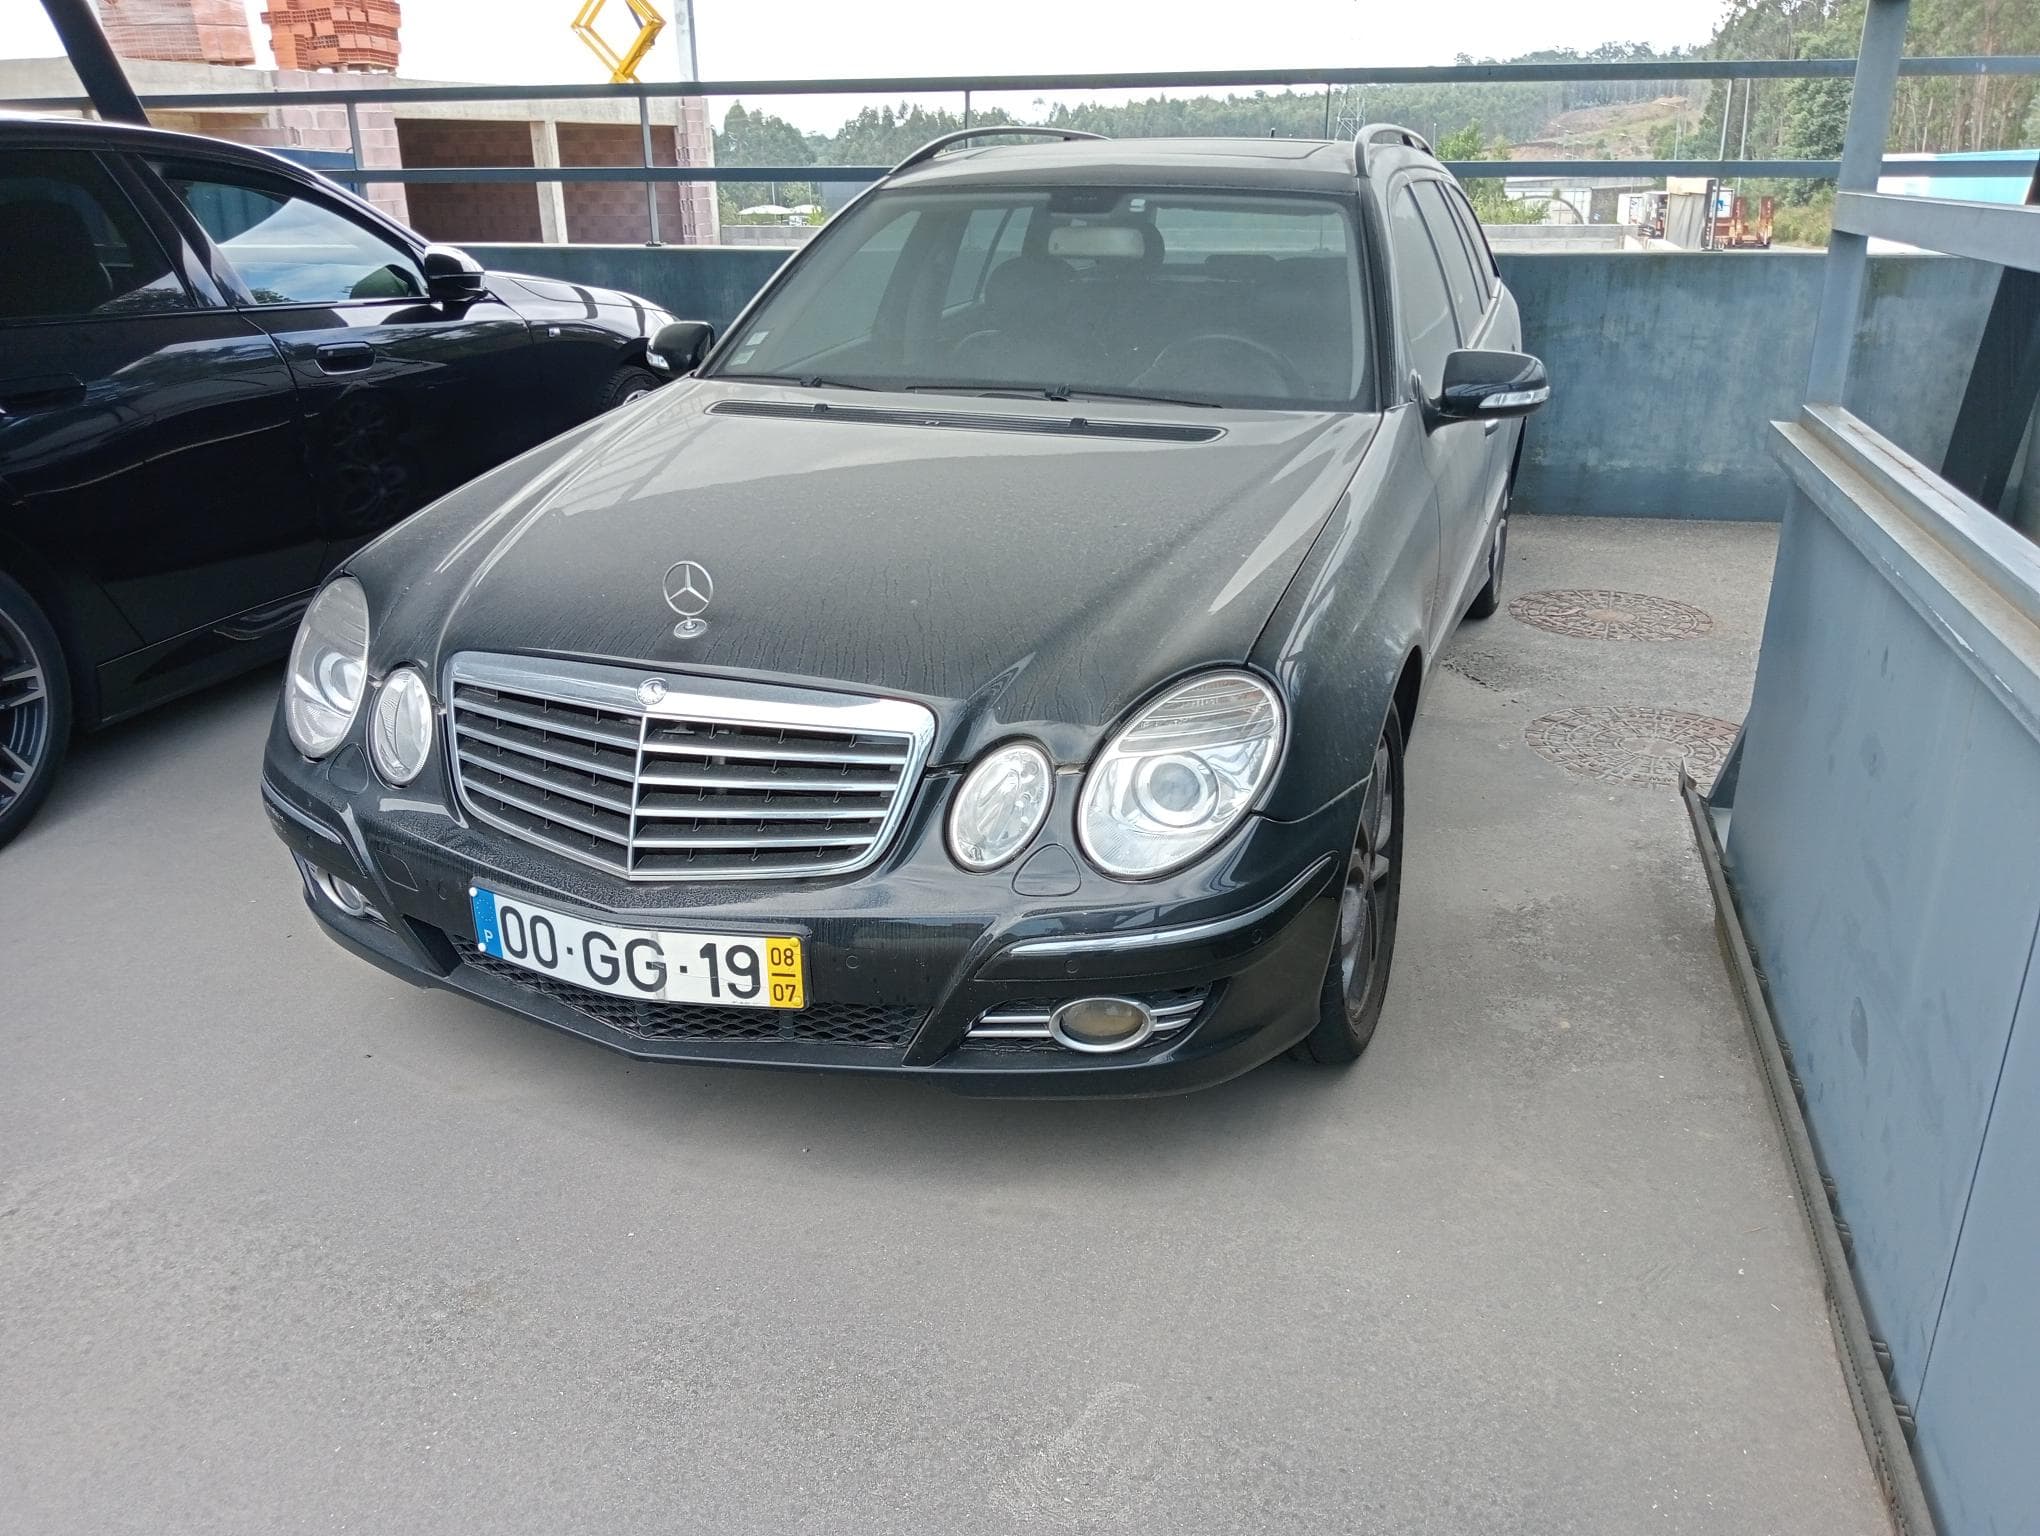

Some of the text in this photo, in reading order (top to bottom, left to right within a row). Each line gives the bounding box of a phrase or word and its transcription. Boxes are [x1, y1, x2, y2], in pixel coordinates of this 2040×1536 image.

[484, 930, 494, 943] P
[771, 947, 795, 966] 08
[774, 985, 796, 1002] 07
